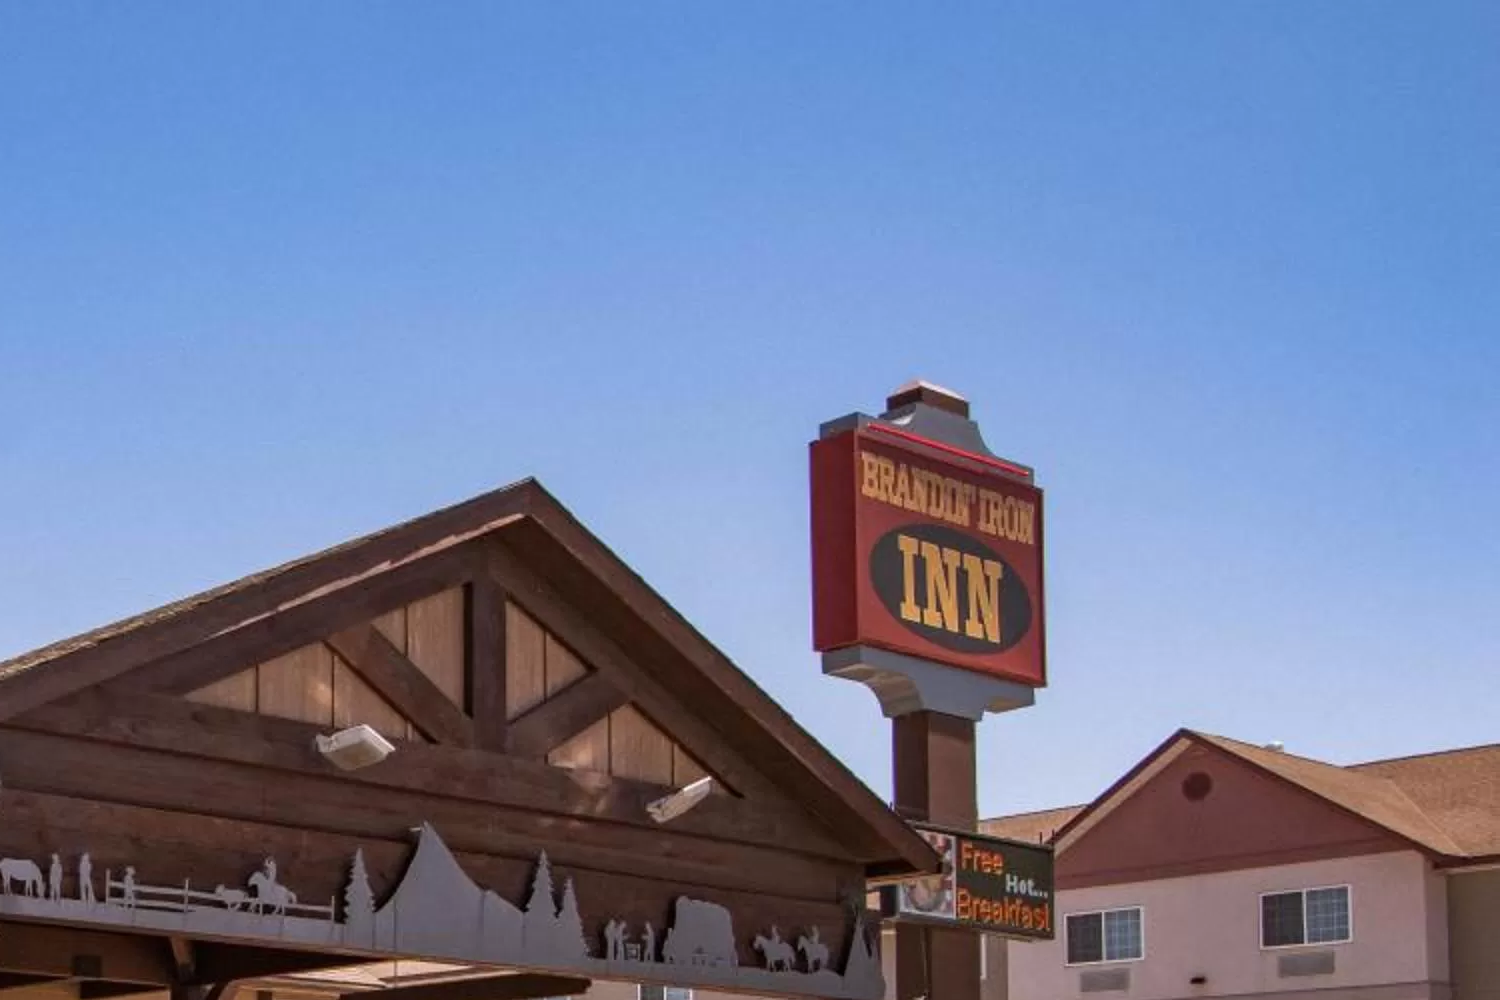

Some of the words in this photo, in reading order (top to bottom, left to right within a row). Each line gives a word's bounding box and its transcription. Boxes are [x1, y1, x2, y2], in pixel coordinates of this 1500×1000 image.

[861, 450, 977, 527] BRANDIN'
[977, 487, 1035, 545] IRON
[897, 534, 1004, 643] INN
[961, 840, 1005, 876] Free
[957, 886, 1051, 931] Breakfast
